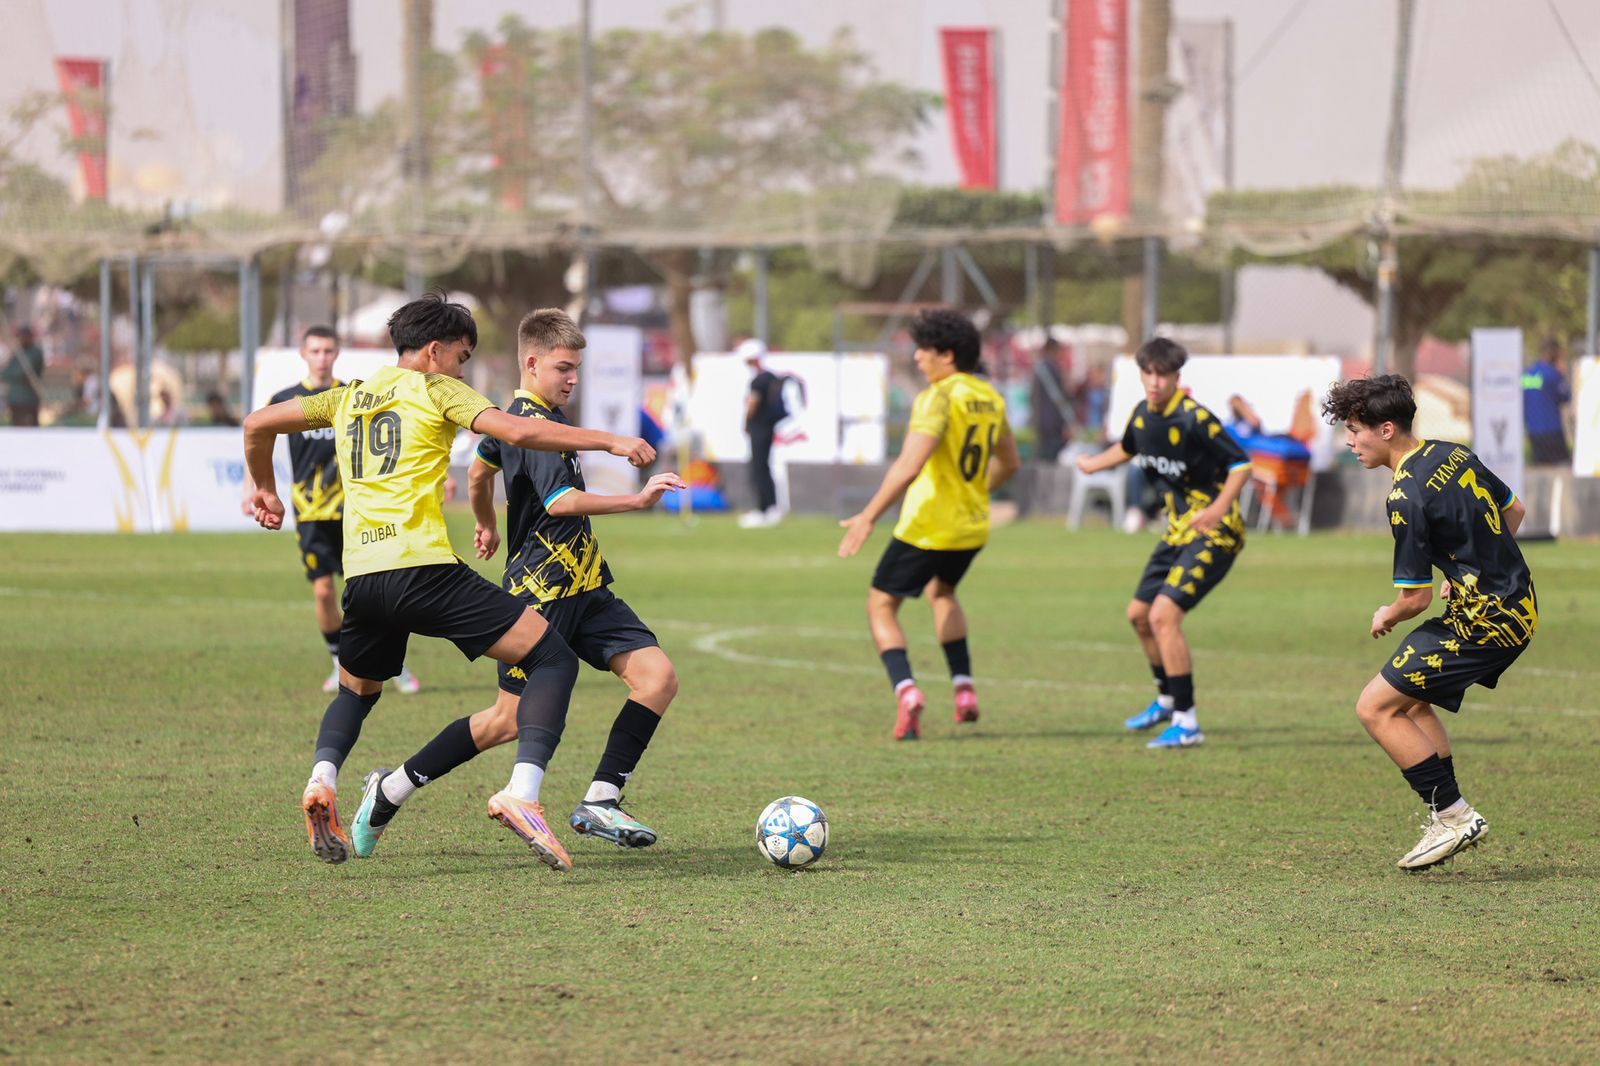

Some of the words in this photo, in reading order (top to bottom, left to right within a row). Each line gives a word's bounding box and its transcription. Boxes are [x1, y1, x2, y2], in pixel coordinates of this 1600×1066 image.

[346, 411, 402, 480] 19
[1458, 468, 1501, 535] 3
[361, 523, 398, 545] DUBAI
[1392, 644, 1415, 669] 3
